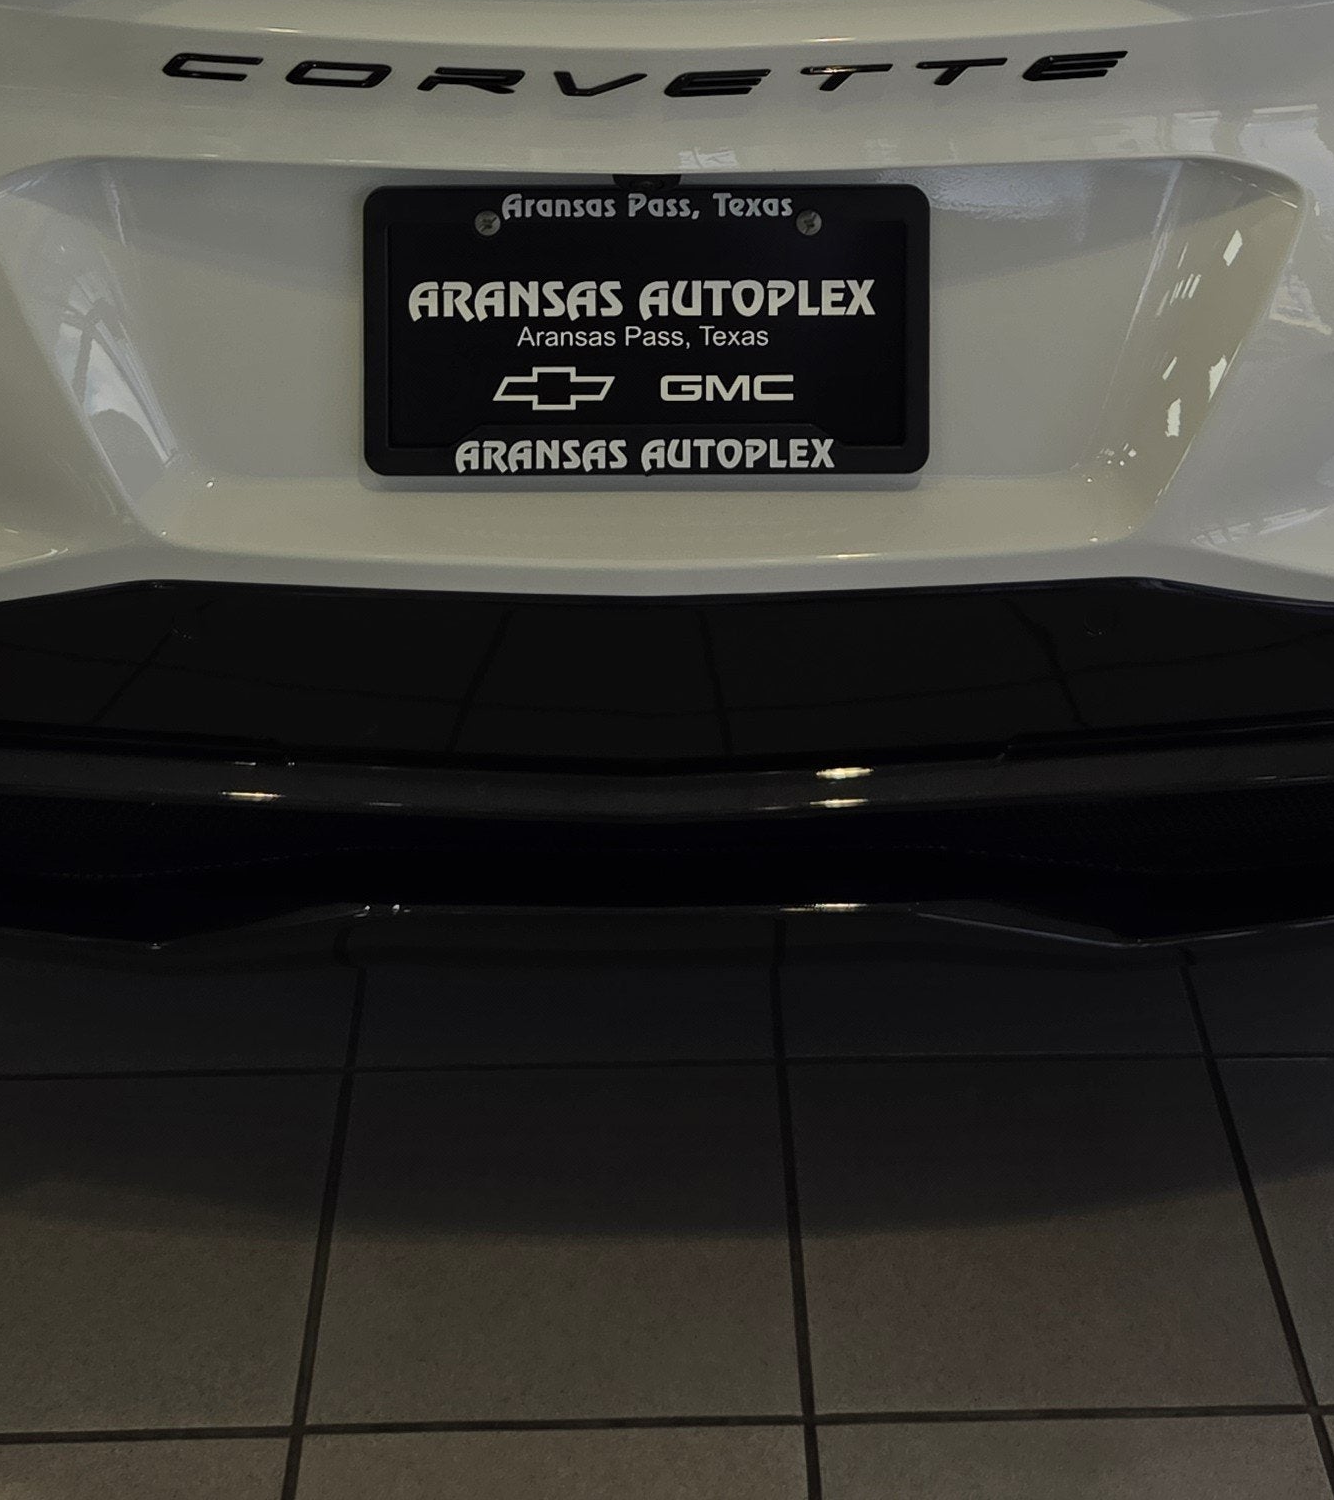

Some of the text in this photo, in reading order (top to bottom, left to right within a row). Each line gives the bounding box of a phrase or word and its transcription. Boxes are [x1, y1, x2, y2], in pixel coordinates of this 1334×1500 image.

[162, 50, 1128, 97] CORVETTE
[502, 192, 793, 220] Aransas Pass, Texas
[408, 279, 876, 322] ARANSAS AUTOPLEX
[517, 325, 769, 349] Aransas Pass, Texas
[660, 374, 794, 401] GMC
[455, 438, 834, 474] ARANSAS AUTOPLEX
